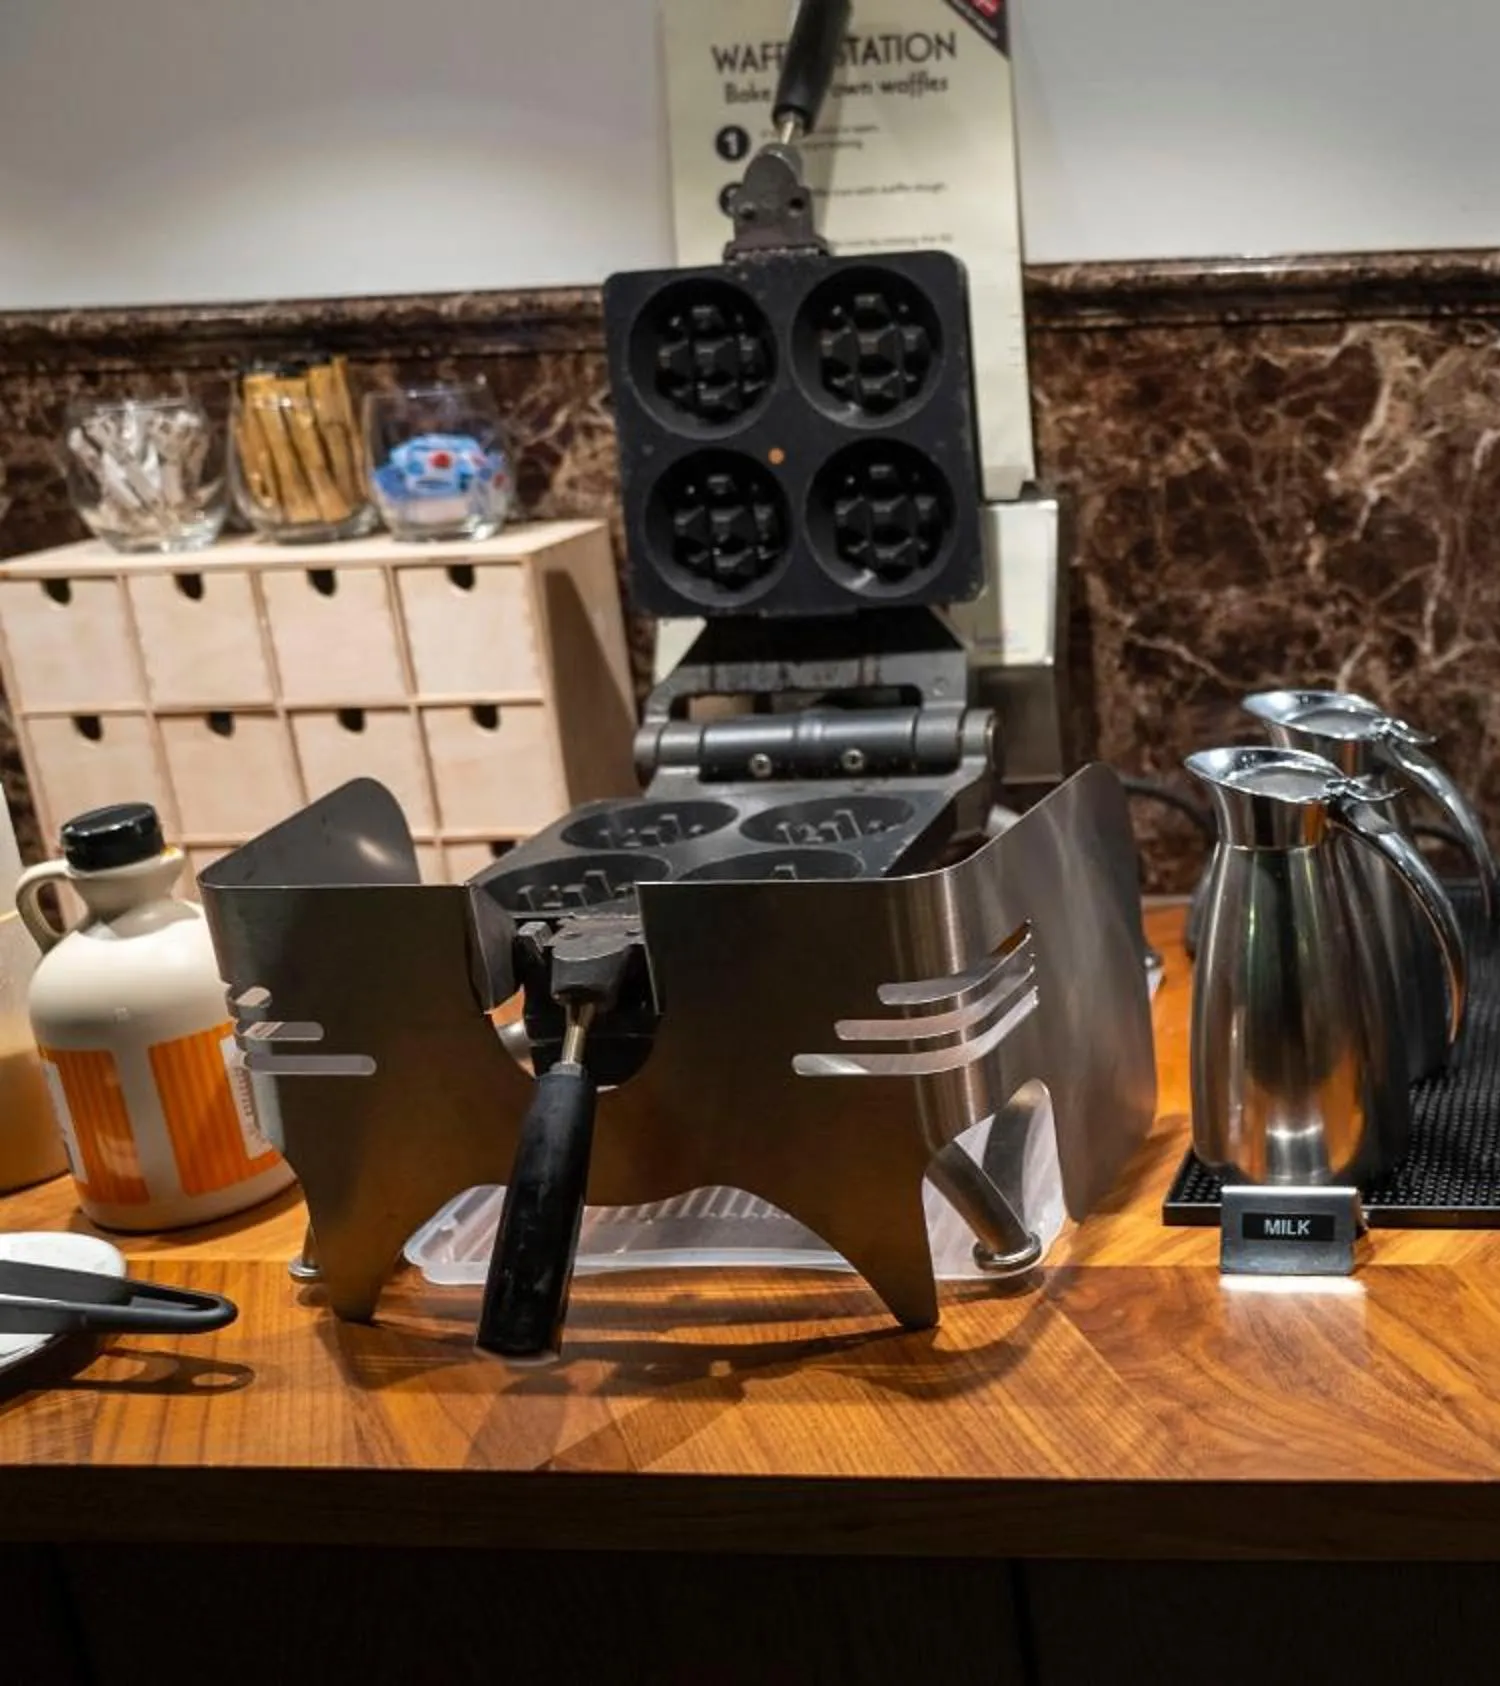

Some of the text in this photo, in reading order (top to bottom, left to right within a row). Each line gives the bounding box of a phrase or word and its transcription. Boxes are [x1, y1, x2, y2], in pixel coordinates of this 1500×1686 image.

[711, 42, 789, 75] WAFF
[724, 81, 772, 104] Bake
[879, 70, 948, 98] waffles
[1264, 1219, 1311, 1236] MILK
